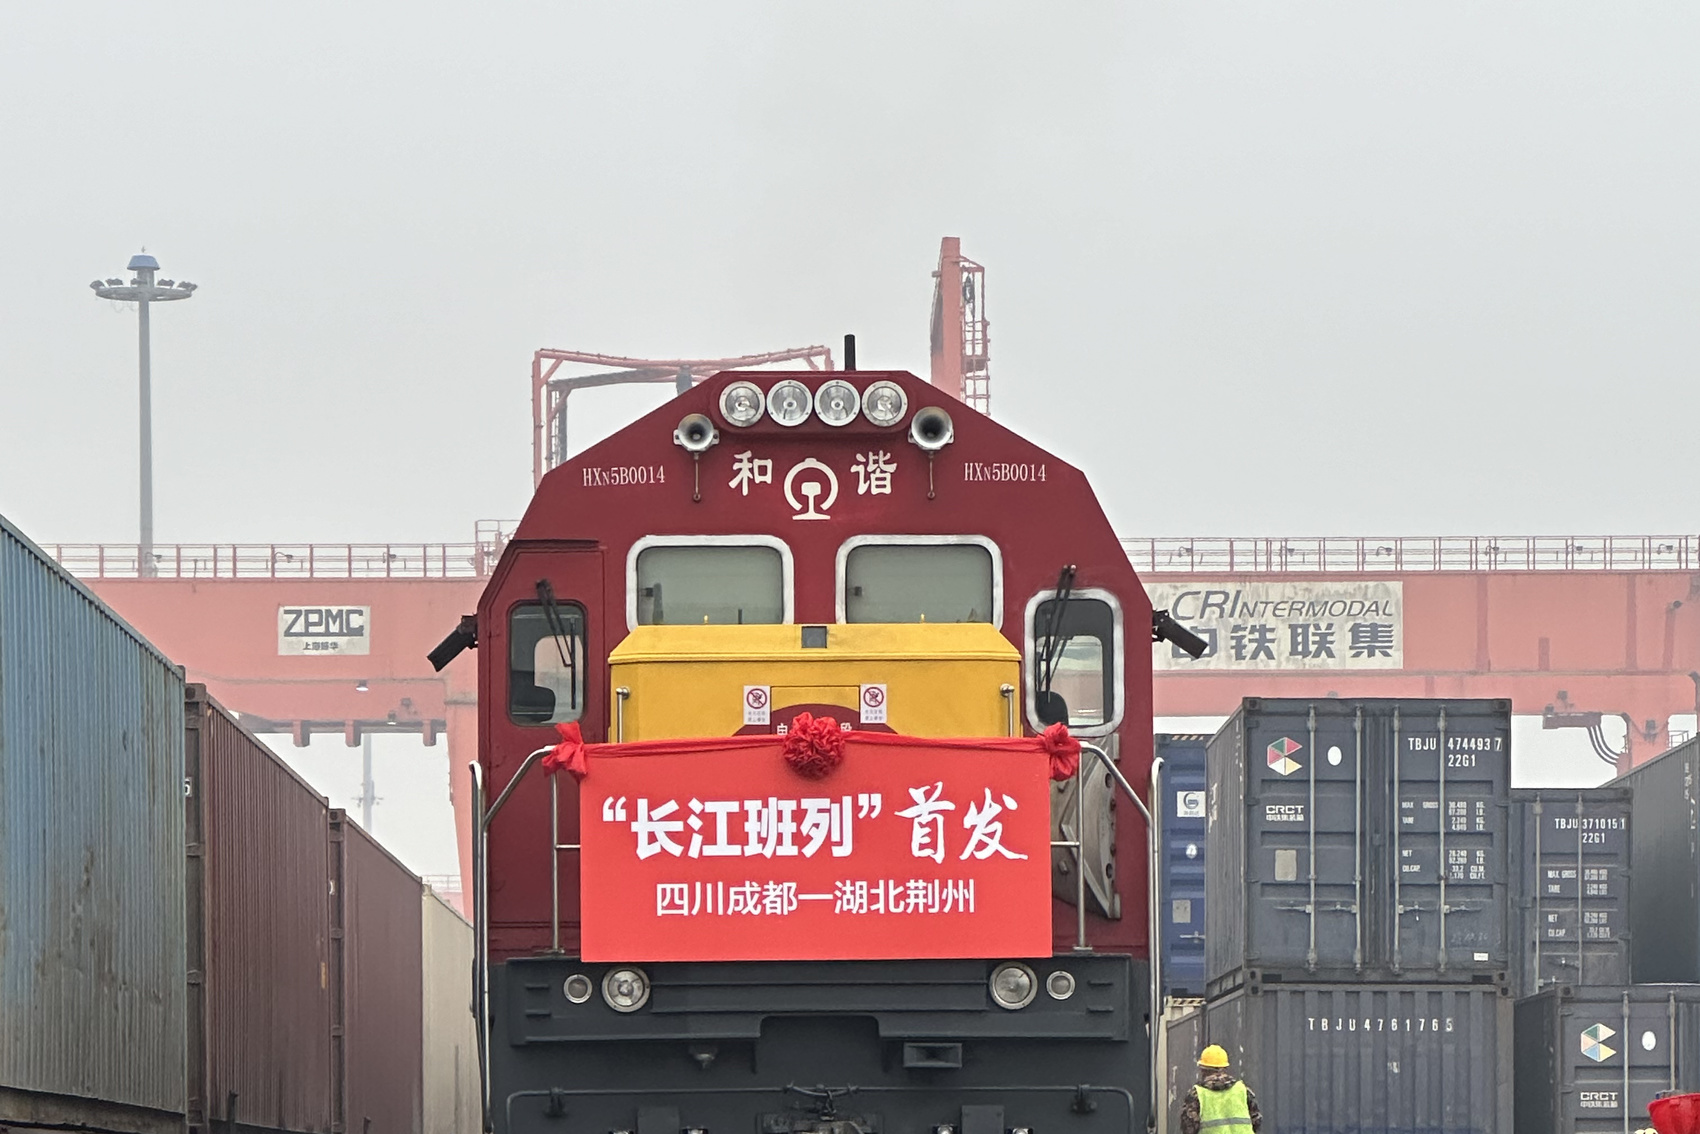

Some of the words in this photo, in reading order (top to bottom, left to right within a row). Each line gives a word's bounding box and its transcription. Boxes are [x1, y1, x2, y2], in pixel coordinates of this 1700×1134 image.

[728, 450, 773, 496] 和
[851, 450, 898, 495] 谐
[283, 608, 365, 637] ZPMC
[1408, 737, 1437, 751] TBJU
[1447, 754, 1476, 767] 22G1
[1265, 805, 1305, 814] CRCT
[1554, 818, 1578, 829] TBJU
[1582, 833, 1605, 844] 22G1
[1580, 1091, 1619, 1101] CRCT
